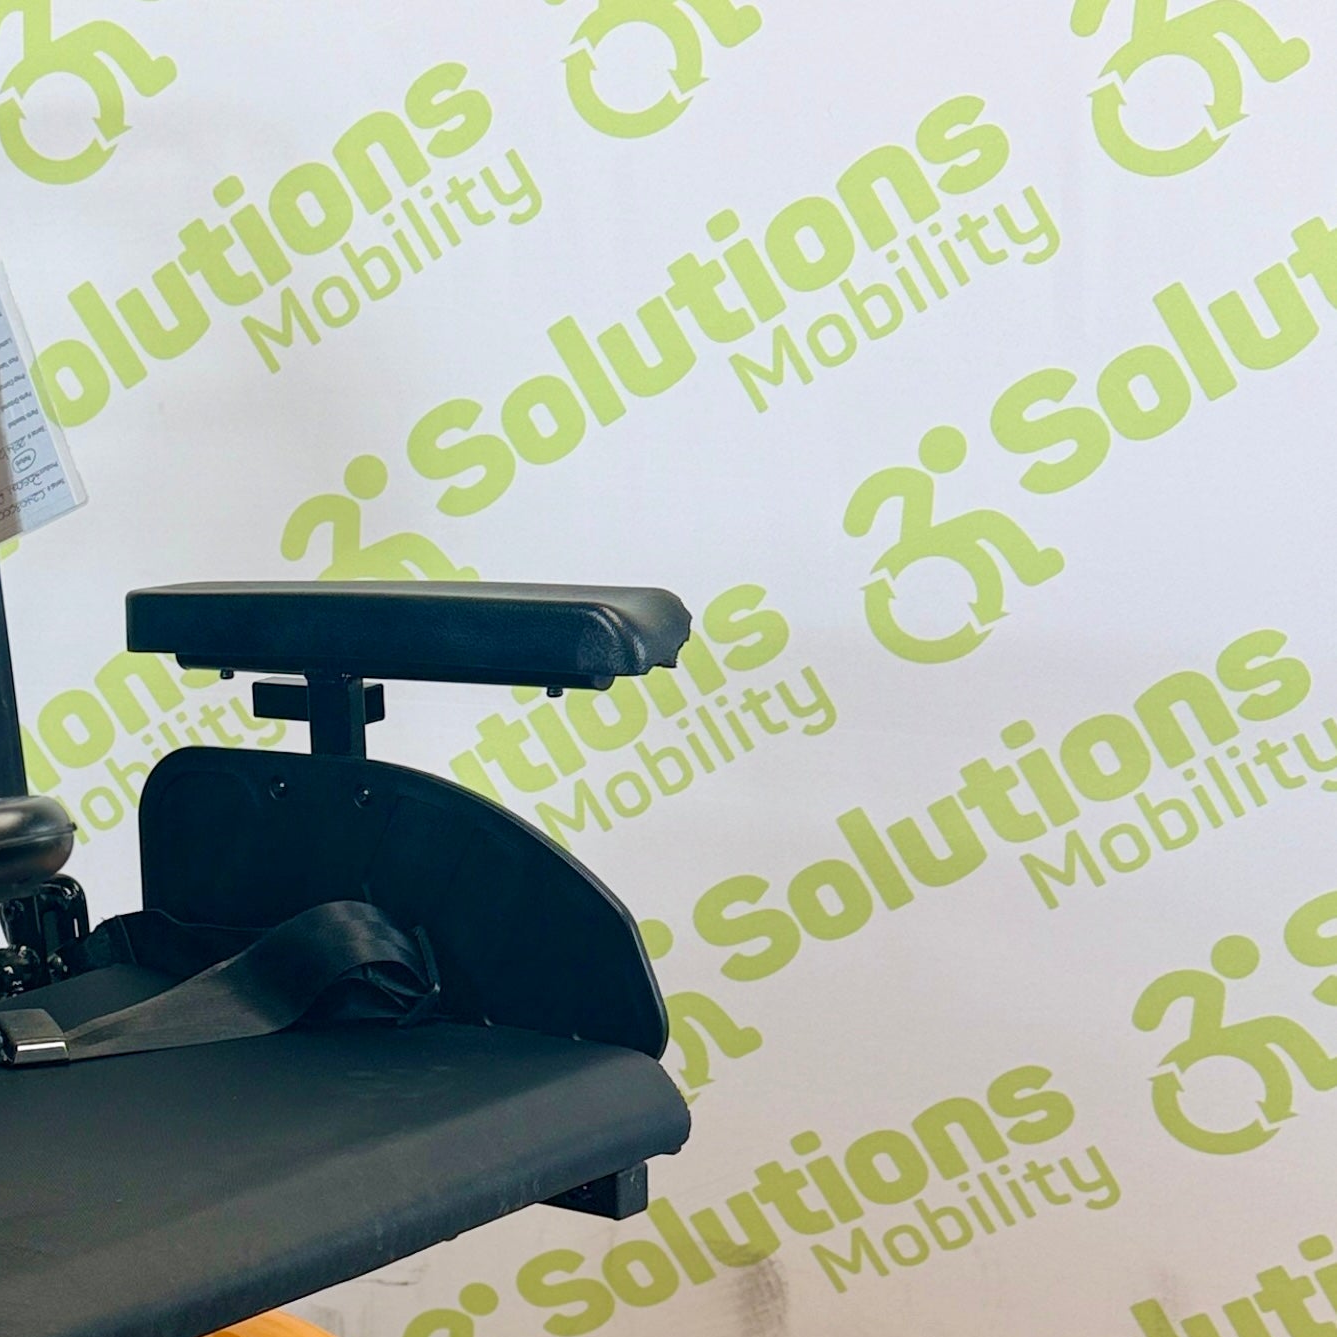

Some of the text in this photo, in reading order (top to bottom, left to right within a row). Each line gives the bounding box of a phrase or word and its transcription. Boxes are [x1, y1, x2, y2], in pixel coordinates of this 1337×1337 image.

[240, 147, 543, 375] Mobility
[405, 95, 1011, 518] Solutions
[727, 184, 1061, 415] Mobility
[534, 664, 840, 850] Mobility
[690, 627, 1314, 985] Solutions
[808, 1145, 1123, 1296] Mobility
